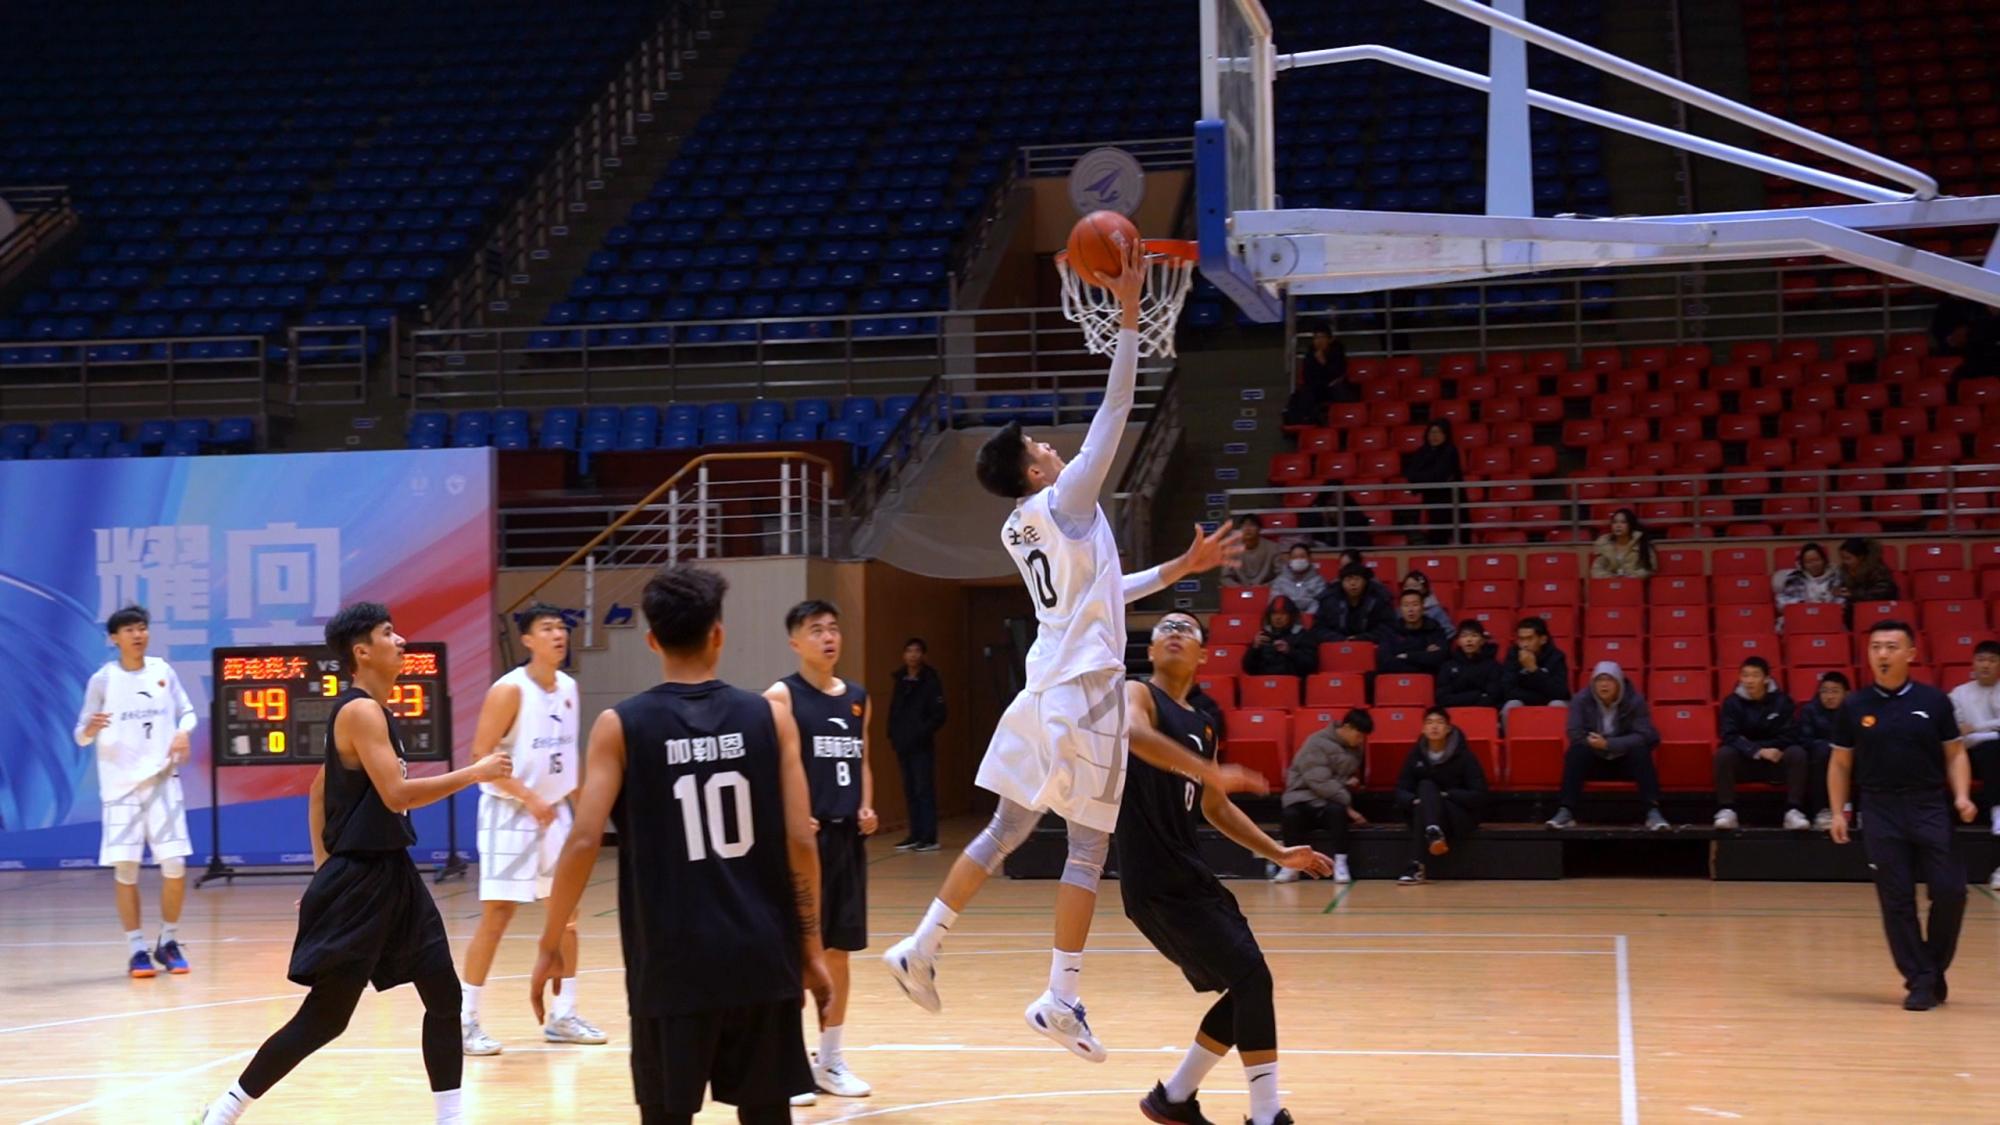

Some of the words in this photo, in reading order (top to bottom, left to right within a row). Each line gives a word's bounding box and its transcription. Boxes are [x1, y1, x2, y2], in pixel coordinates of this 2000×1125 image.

[316, 660, 340, 671] VS
[322, 675, 338, 697] 3
[243, 687, 287, 720] 49
[143, 722, 152, 739] 7
[268, 731, 285, 753] 0
[664, 732, 746, 766] 加勒恩
[836, 761, 851, 786] 8
[672, 770, 756, 862] 10
